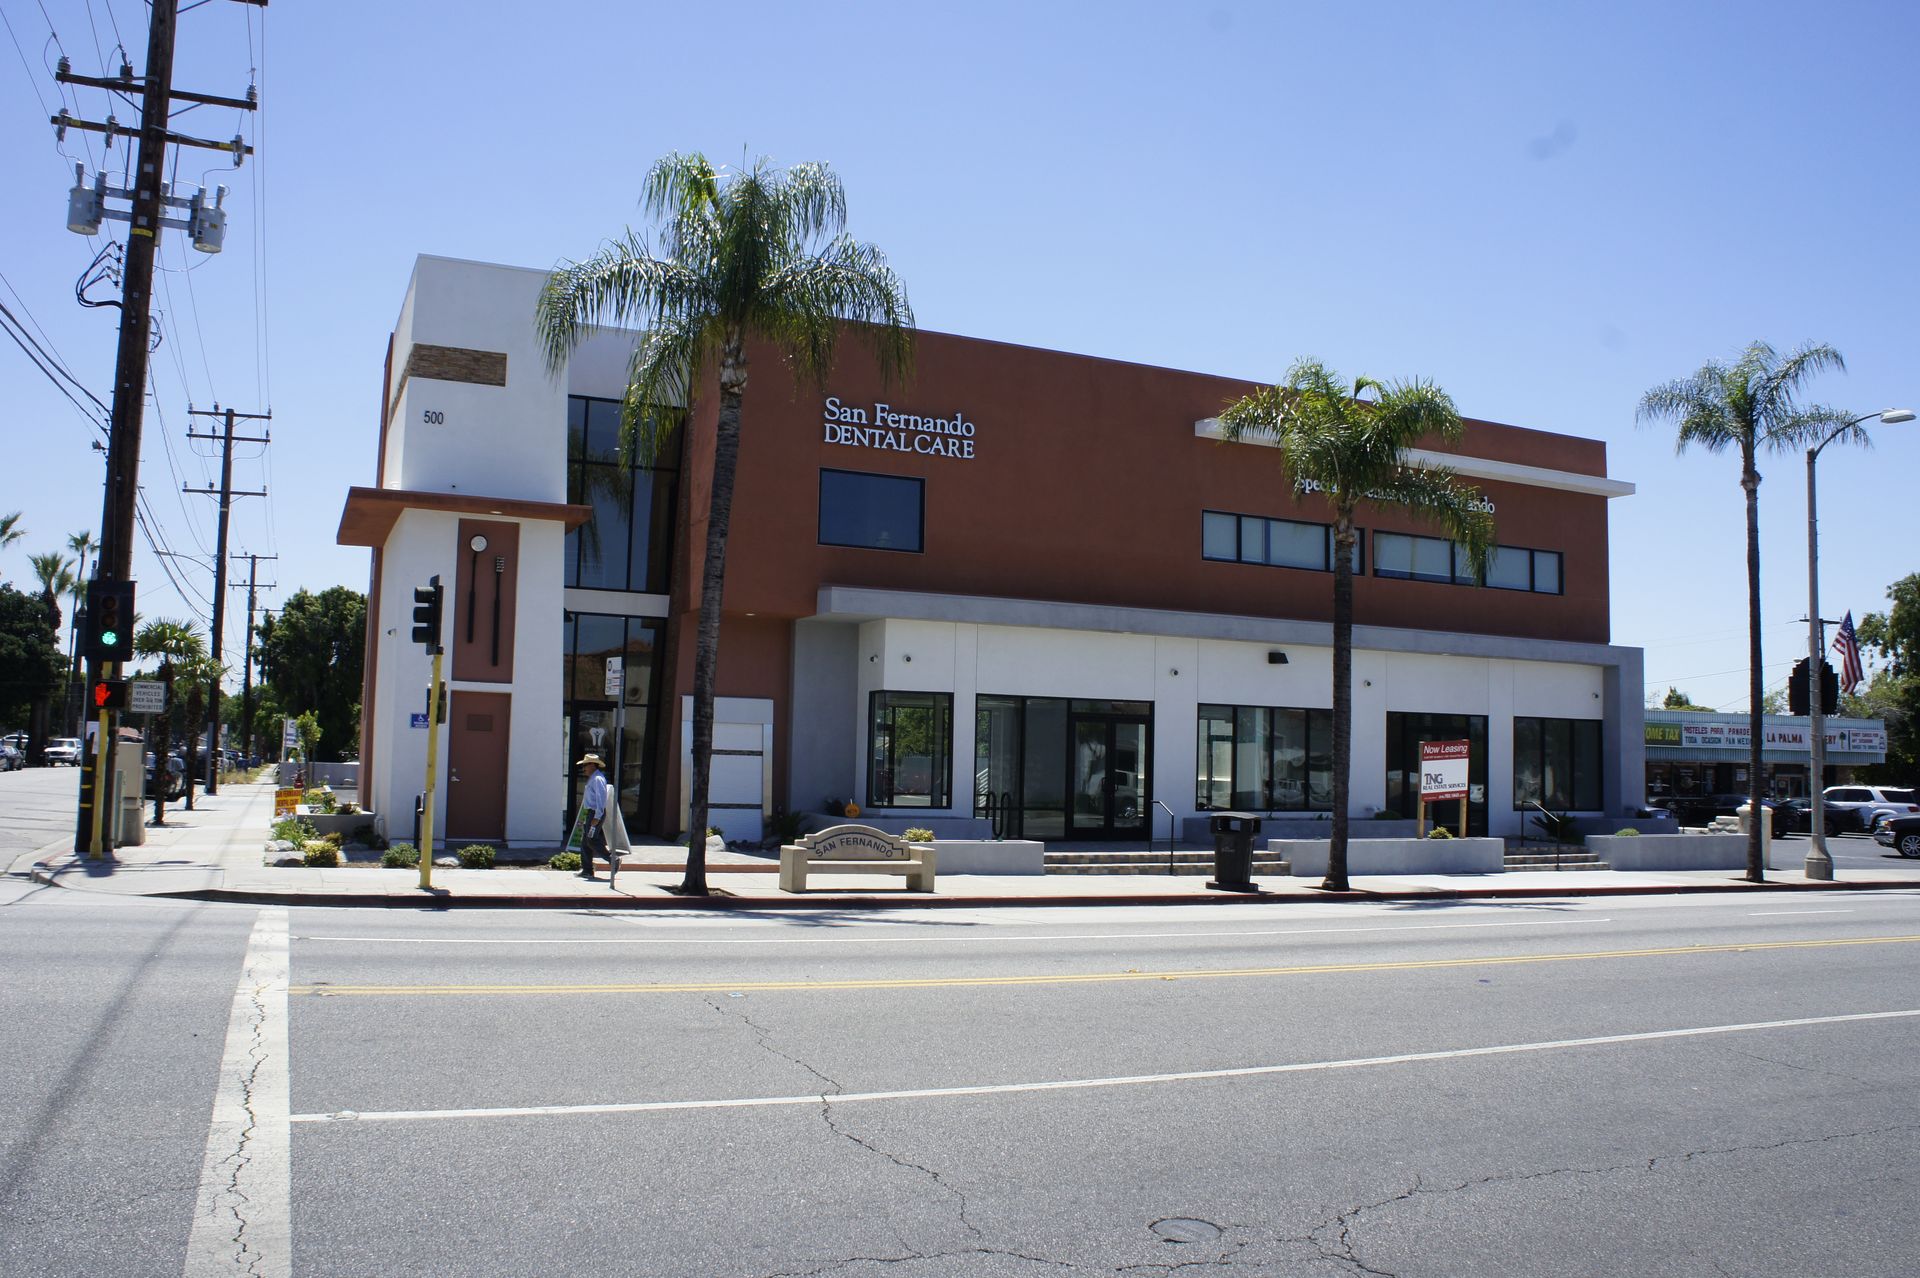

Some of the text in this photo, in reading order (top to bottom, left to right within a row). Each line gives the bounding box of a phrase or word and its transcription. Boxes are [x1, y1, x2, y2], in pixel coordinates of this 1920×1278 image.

[424, 410, 444, 425] 500
[824, 397, 976, 437] San Fernando
[824, 423, 976, 459] DENTAL CARE
[1665, 728, 1680, 741] TAX
[1684, 726, 1708, 735] PASTELES
[1766, 732, 1776, 743] LA
[1779, 733, 1803, 745] PALMA
[1424, 744, 1468, 754] Now Leasing
[1424, 773, 1443, 785] TNG
[816, 837, 893, 858] SAN FERNANDO
